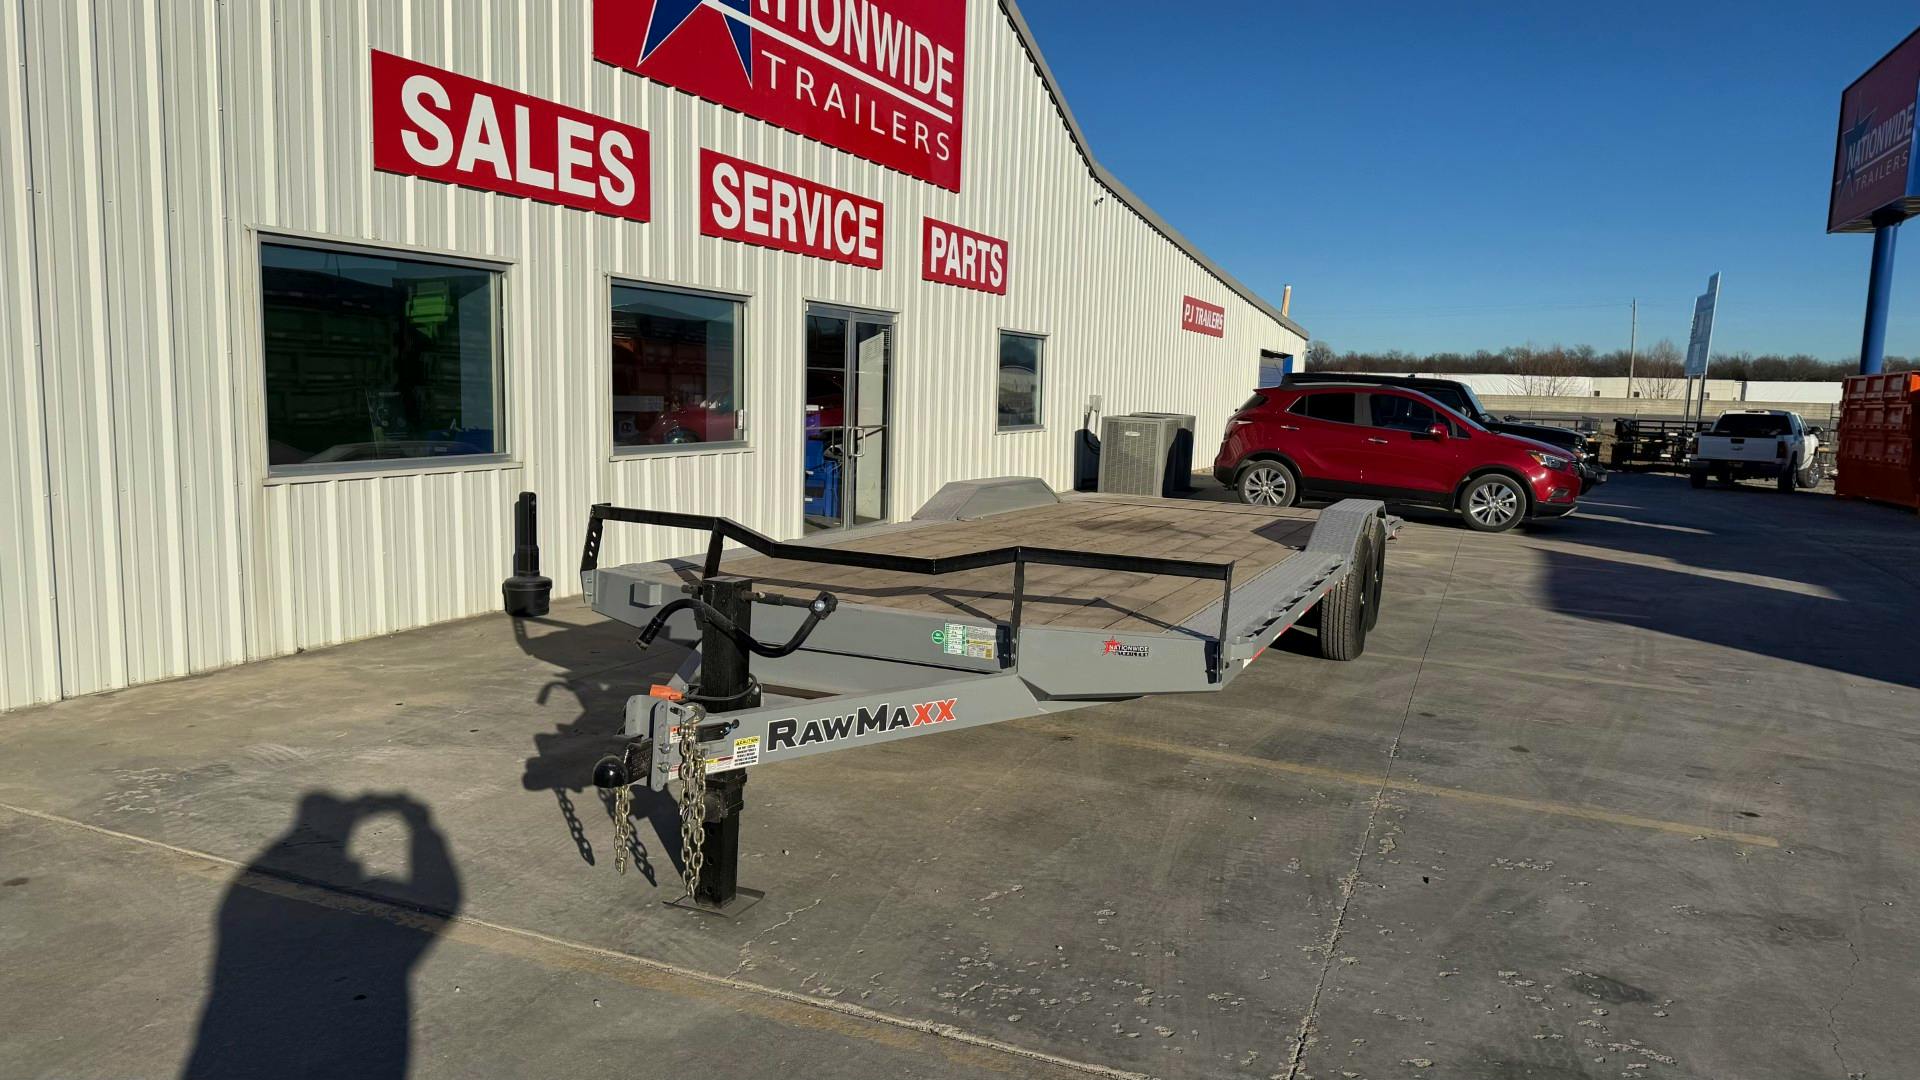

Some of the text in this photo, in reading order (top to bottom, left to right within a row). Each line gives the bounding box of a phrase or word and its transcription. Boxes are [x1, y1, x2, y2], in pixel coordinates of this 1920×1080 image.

[742, 0, 954, 108] ONWIDE
[400, 75, 636, 207] SALES
[761, 50, 950, 161] TRAILERS
[1846, 102, 1915, 173] NATIONWIDE
[1855, 150, 1909, 192] TRAILERS
[711, 162, 878, 260] SERVICE
[930, 227, 1004, 288] PARTS
[1184, 303, 1223, 329] PJ TRAILERS
[1109, 644, 1149, 652] NATIONWIDE
